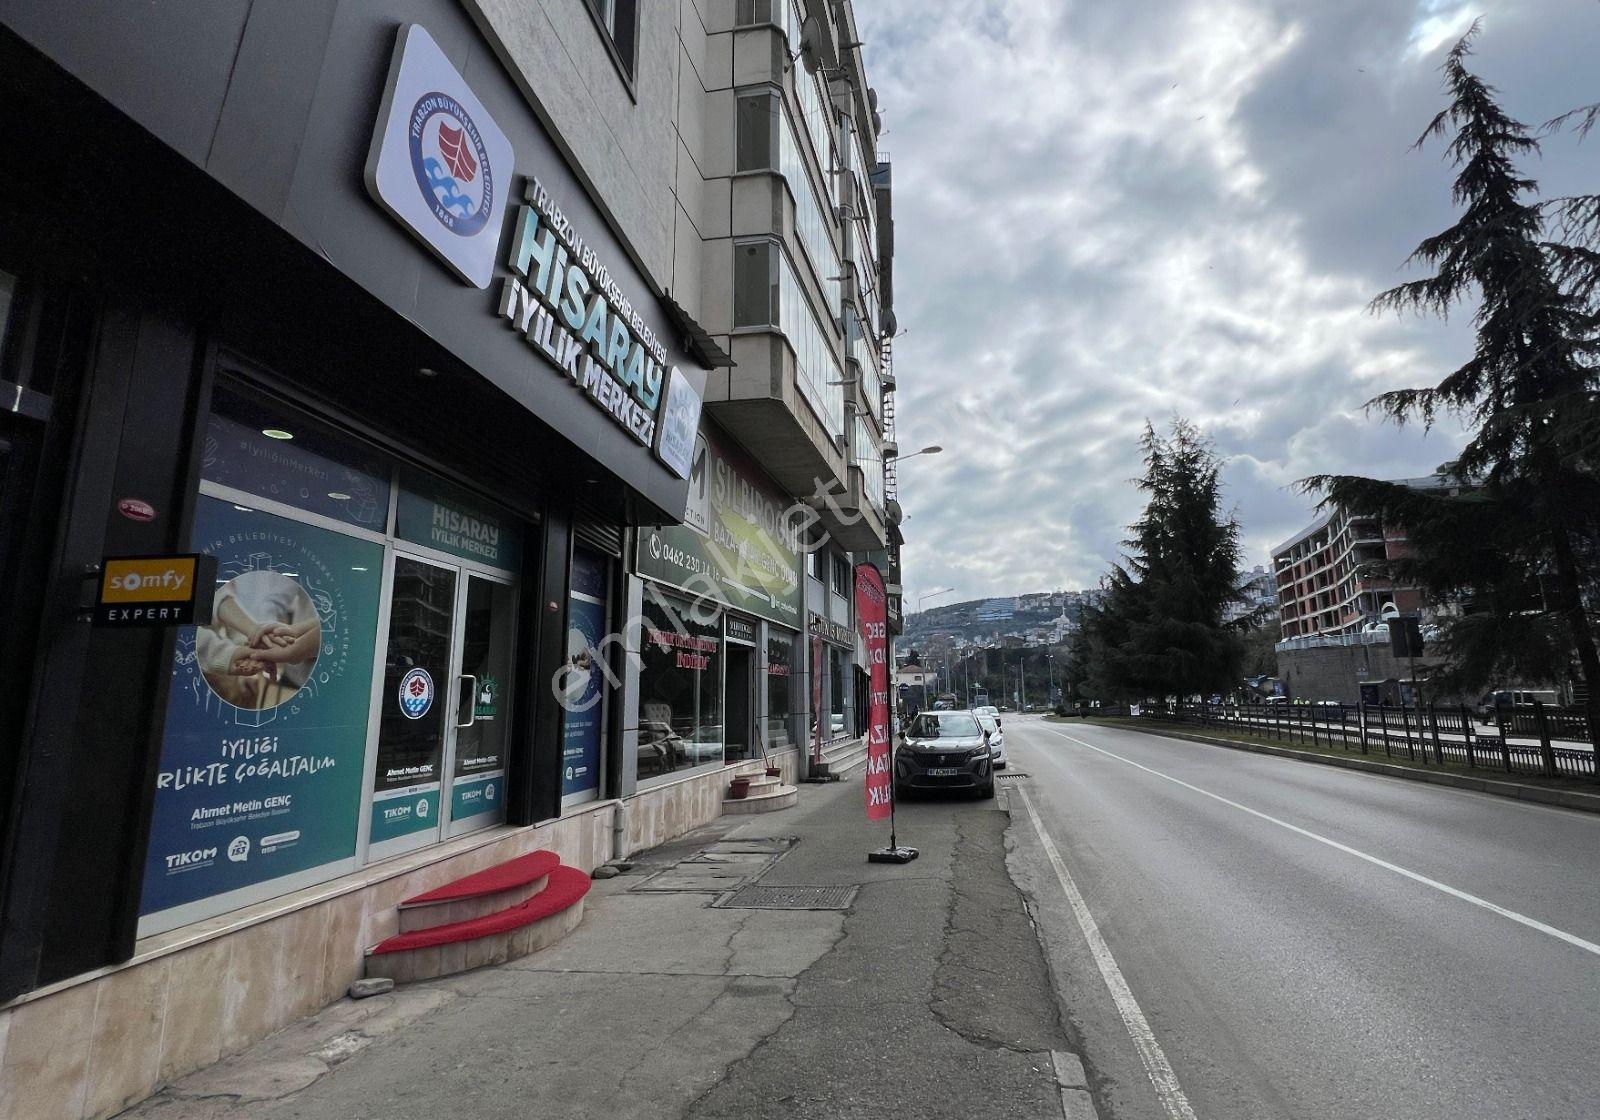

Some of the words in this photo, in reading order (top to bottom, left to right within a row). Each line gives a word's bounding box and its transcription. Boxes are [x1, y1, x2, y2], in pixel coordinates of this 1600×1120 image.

[412, 98, 440, 139] TRABZON
[528, 176, 583, 258] TRABZON
[663, 544, 684, 568] 0462
[686, 555, 700, 573] 230
[110, 570, 185, 590] somfy
[108, 607, 182, 621] EXPERT
[191, 806, 230, 821] Ahmet
[233, 799, 262, 814] Metin
[264, 795, 292, 807] GENÇ
